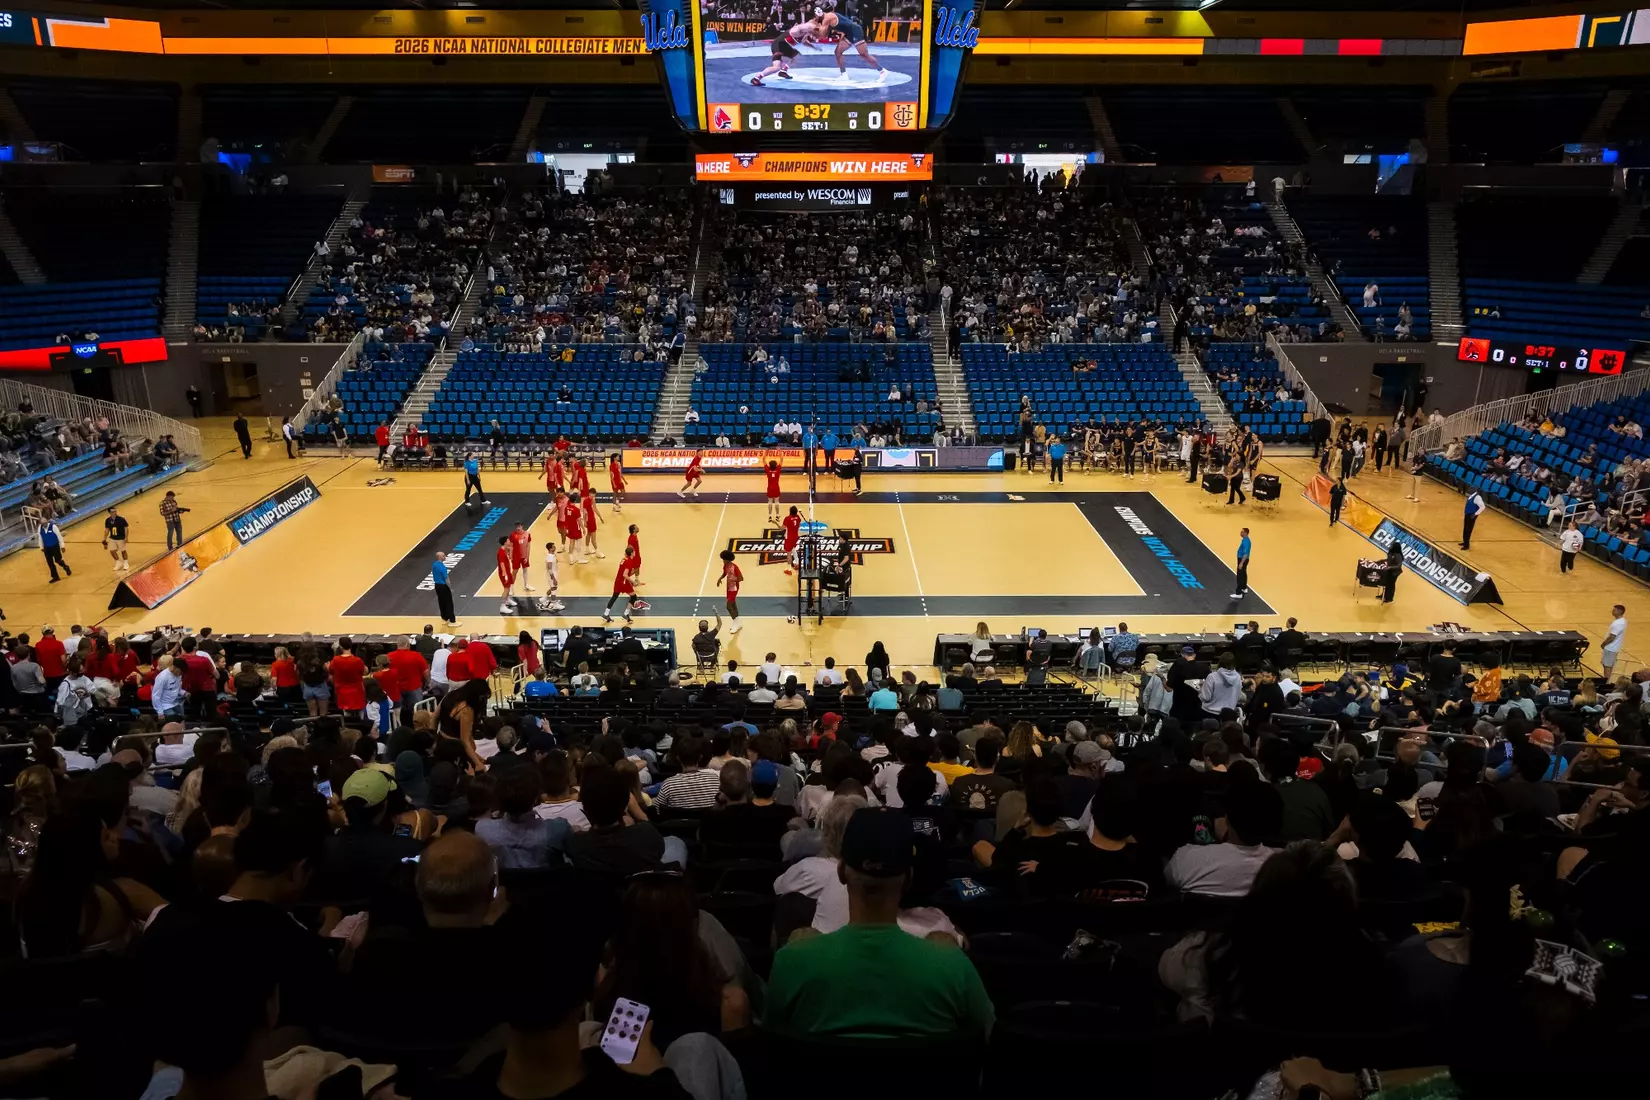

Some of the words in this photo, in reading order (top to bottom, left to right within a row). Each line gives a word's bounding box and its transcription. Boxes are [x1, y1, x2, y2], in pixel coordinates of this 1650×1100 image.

[726, 22, 744, 32] WIN
[745, 22, 766, 32] HER
[394, 39, 429, 53] 2026
[433, 39, 467, 53] NCAA
[471, 39, 532, 53] NATIONAL
[535, 39, 609, 53] COLLEGIATE
[613, 39, 652, 53] MEN'
[794, 105, 831, 119] 9:37
[748, 112, 761, 130] 0
[868, 111, 881, 130] 0
[704, 161, 731, 173] HERE
[764, 161, 828, 173] CHAMPIONS
[830, 161, 867, 173] WIN
[870, 161, 908, 173] HERE
[755, 191, 792, 201] presented
[794, 191, 805, 201] by
[807, 188, 856, 200] WESCOM
[75, 345, 97, 354] NCAA
[1492, 348, 1504, 361] 0
[1525, 345, 1555, 357] 9:37
[1575, 356, 1588, 370] 0
[642, 457, 759, 466] CHAMPONSHIP
[237, 487, 313, 541] CHAMPIONSHIP
[453, 531, 486, 551] WIN
[474, 506, 508, 529] HERE
[1140, 536, 1175, 557] WIN
[1160, 560, 1205, 589] HERE
[1373, 528, 1473, 595] CHMPIONSHIP
